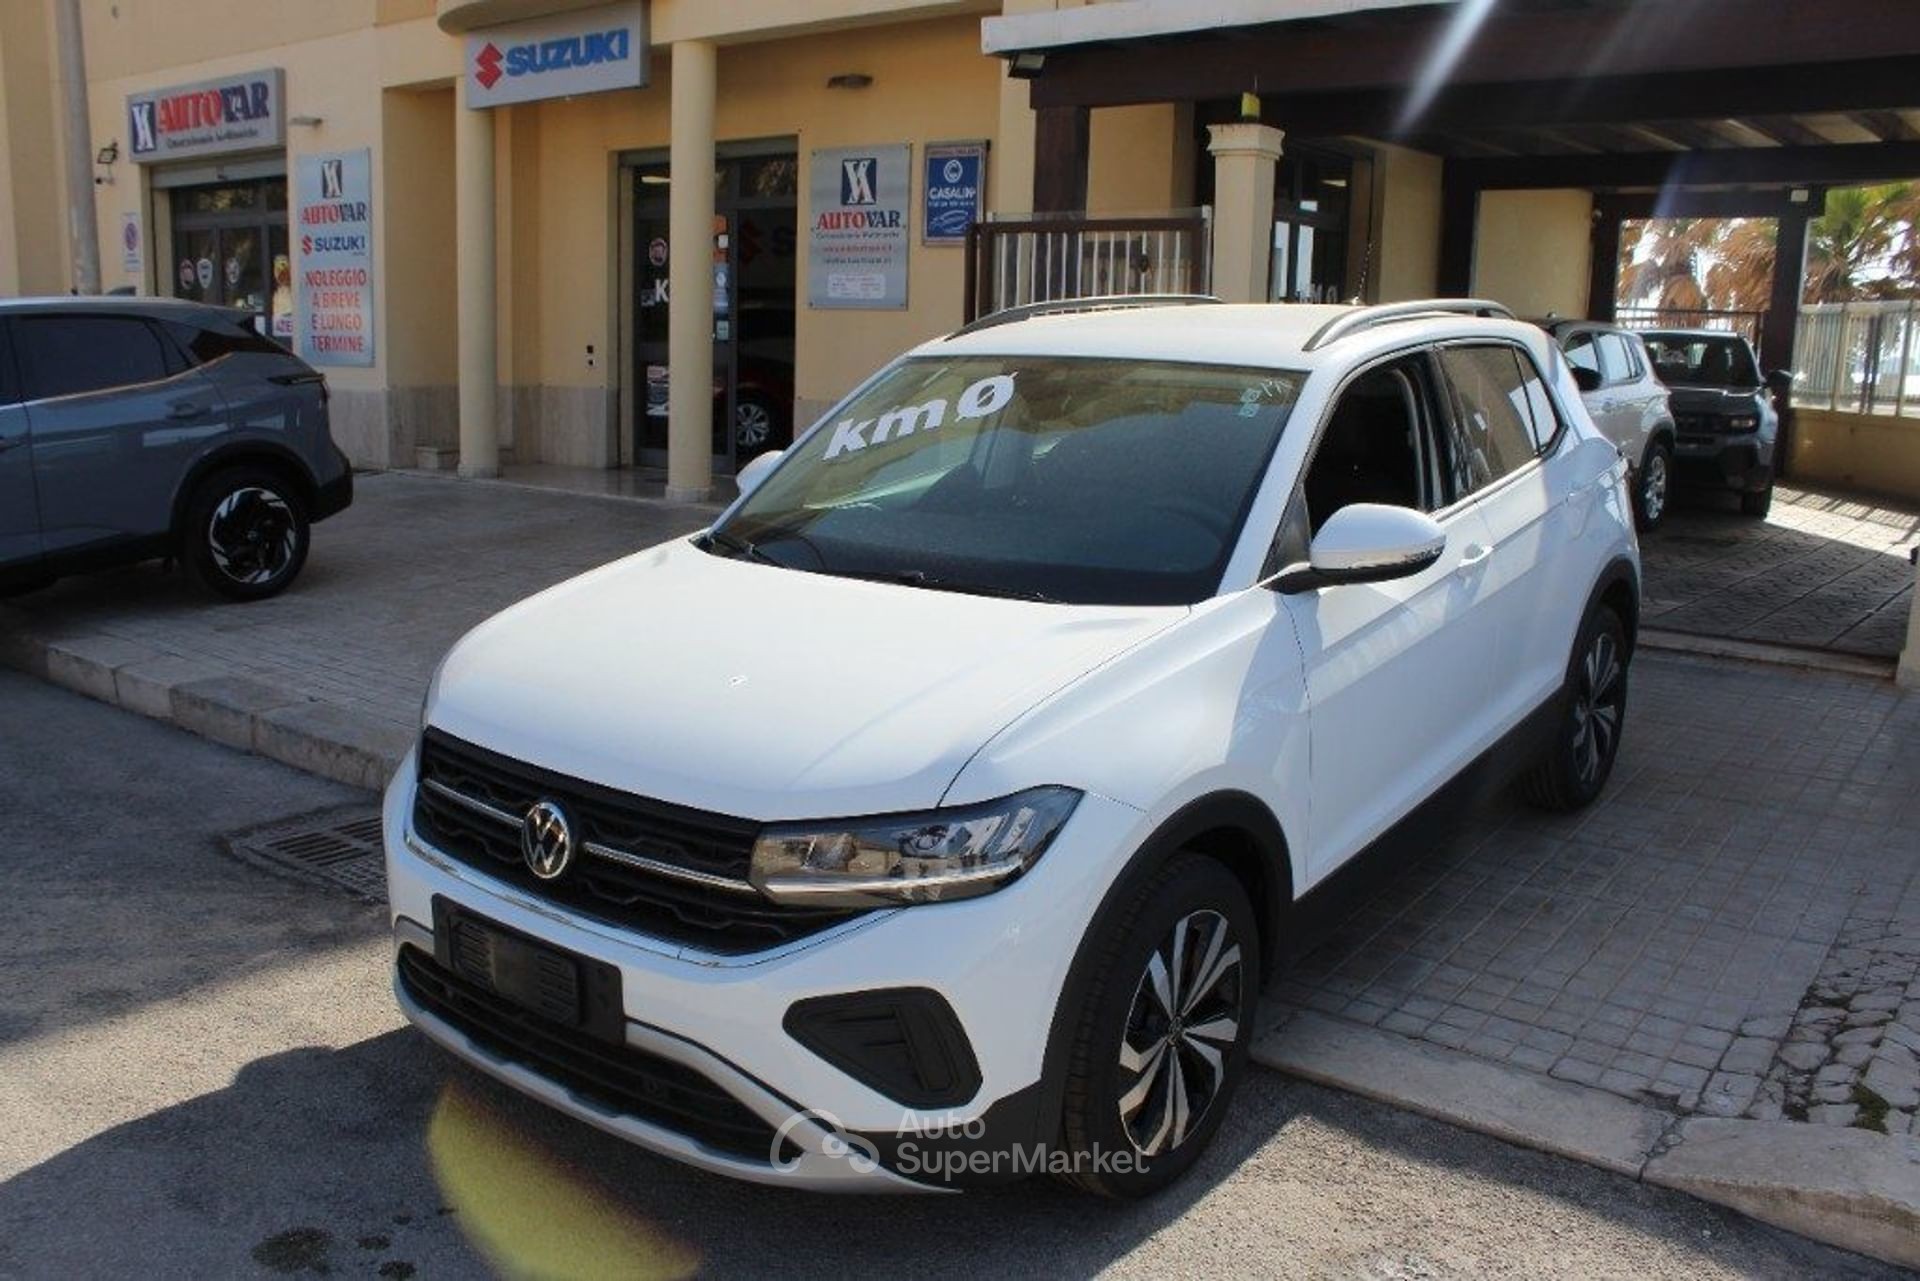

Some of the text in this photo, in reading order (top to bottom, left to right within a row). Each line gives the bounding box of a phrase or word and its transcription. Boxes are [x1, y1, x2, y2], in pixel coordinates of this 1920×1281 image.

[506, 28, 628, 77] SUZUKI
[158, 81, 270, 133] AUTOVAR
[302, 202, 367, 224] AUTOVAR
[816, 210, 901, 230] AUTOVAR
[314, 236, 366, 252] SUZUKI
[305, 269, 367, 287] NOLEGGIO
[312, 291, 360, 308] A BREVE
[312, 314, 362, 331] E LUNGO
[312, 336, 364, 353] TERMINE
